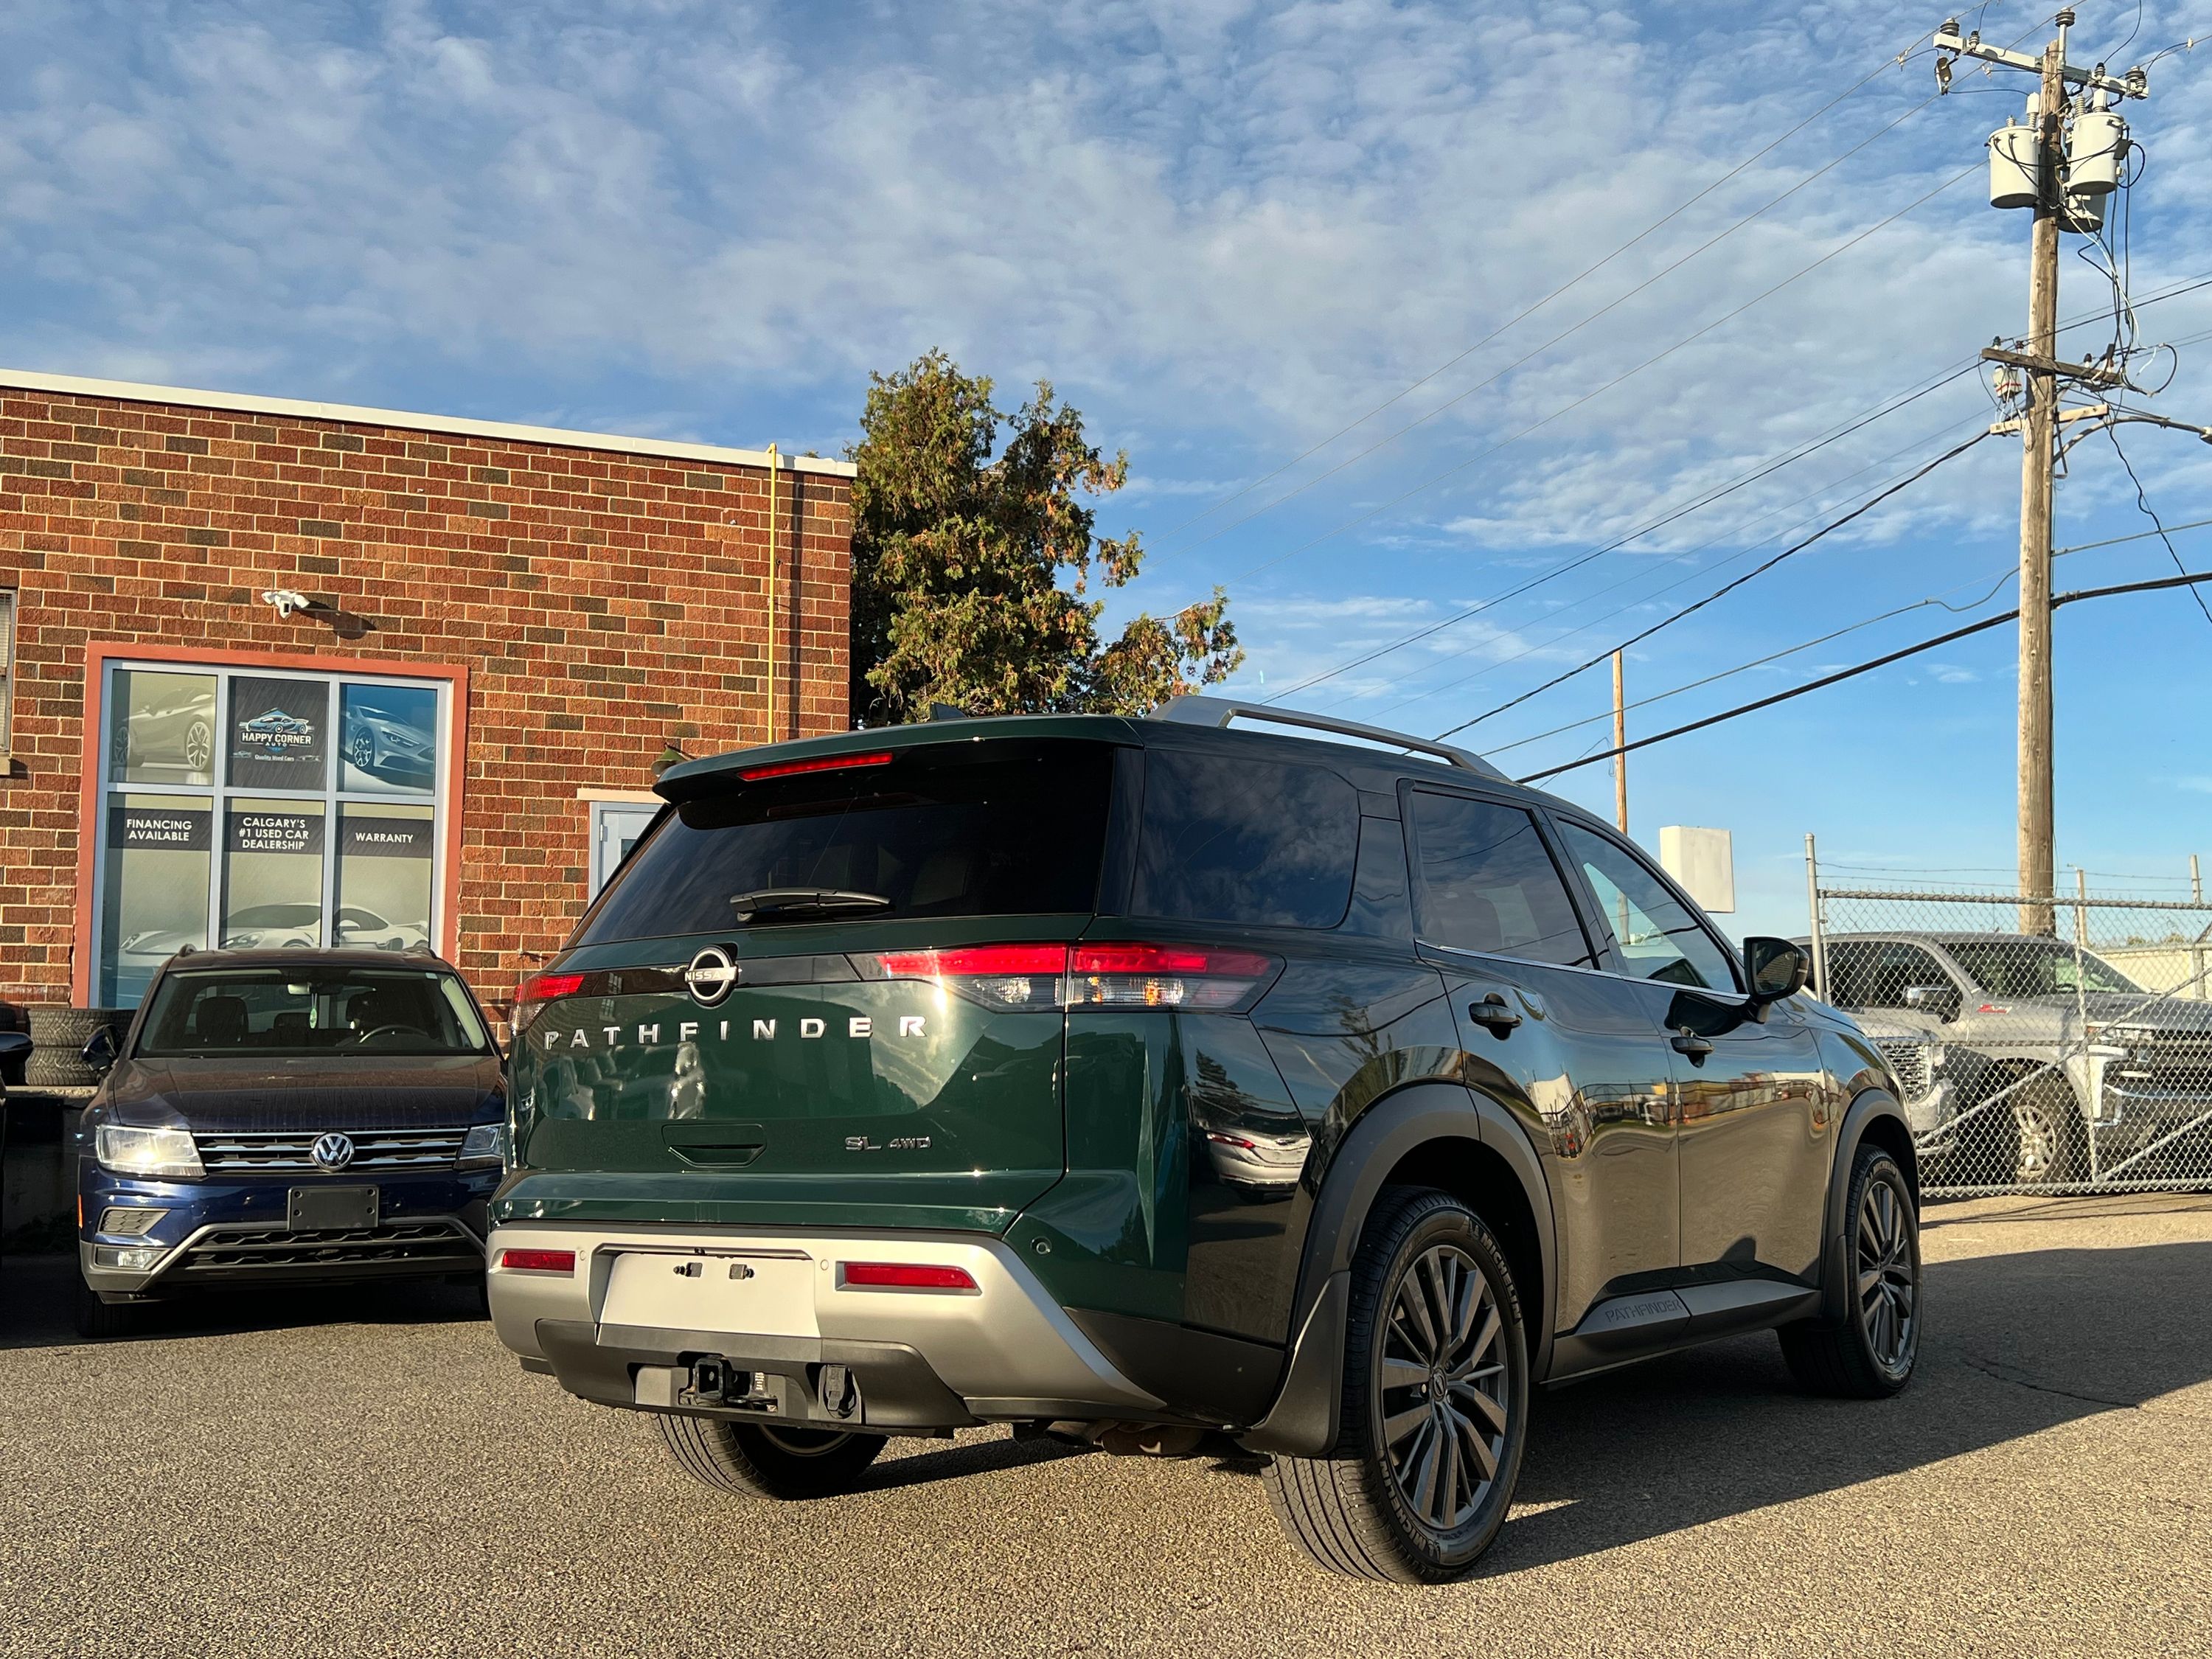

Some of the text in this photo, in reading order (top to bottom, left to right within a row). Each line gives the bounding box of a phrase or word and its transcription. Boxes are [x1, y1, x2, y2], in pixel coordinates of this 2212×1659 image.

[242, 732, 312, 745] HAPPY CORNER
[126, 818, 192, 830] FINANCING
[243, 817, 306, 829] CALGARY'S
[128, 830, 189, 841] AVAILABLE
[238, 828, 309, 840] #1 USED CAR
[355, 832, 414, 844] WARRANTY
[242, 839, 305, 850] DEALERSHIP
[684, 967, 736, 982] NISSA
[543, 1015, 928, 1051] PATHFINDER
[845, 1135, 932, 1151] SL 4WD
[1480, 1231, 1523, 1320] MICHELIN
[1604, 1299, 1682, 1323] PATHFINDER
[1379, 1460, 1427, 1552] MICHELIN
